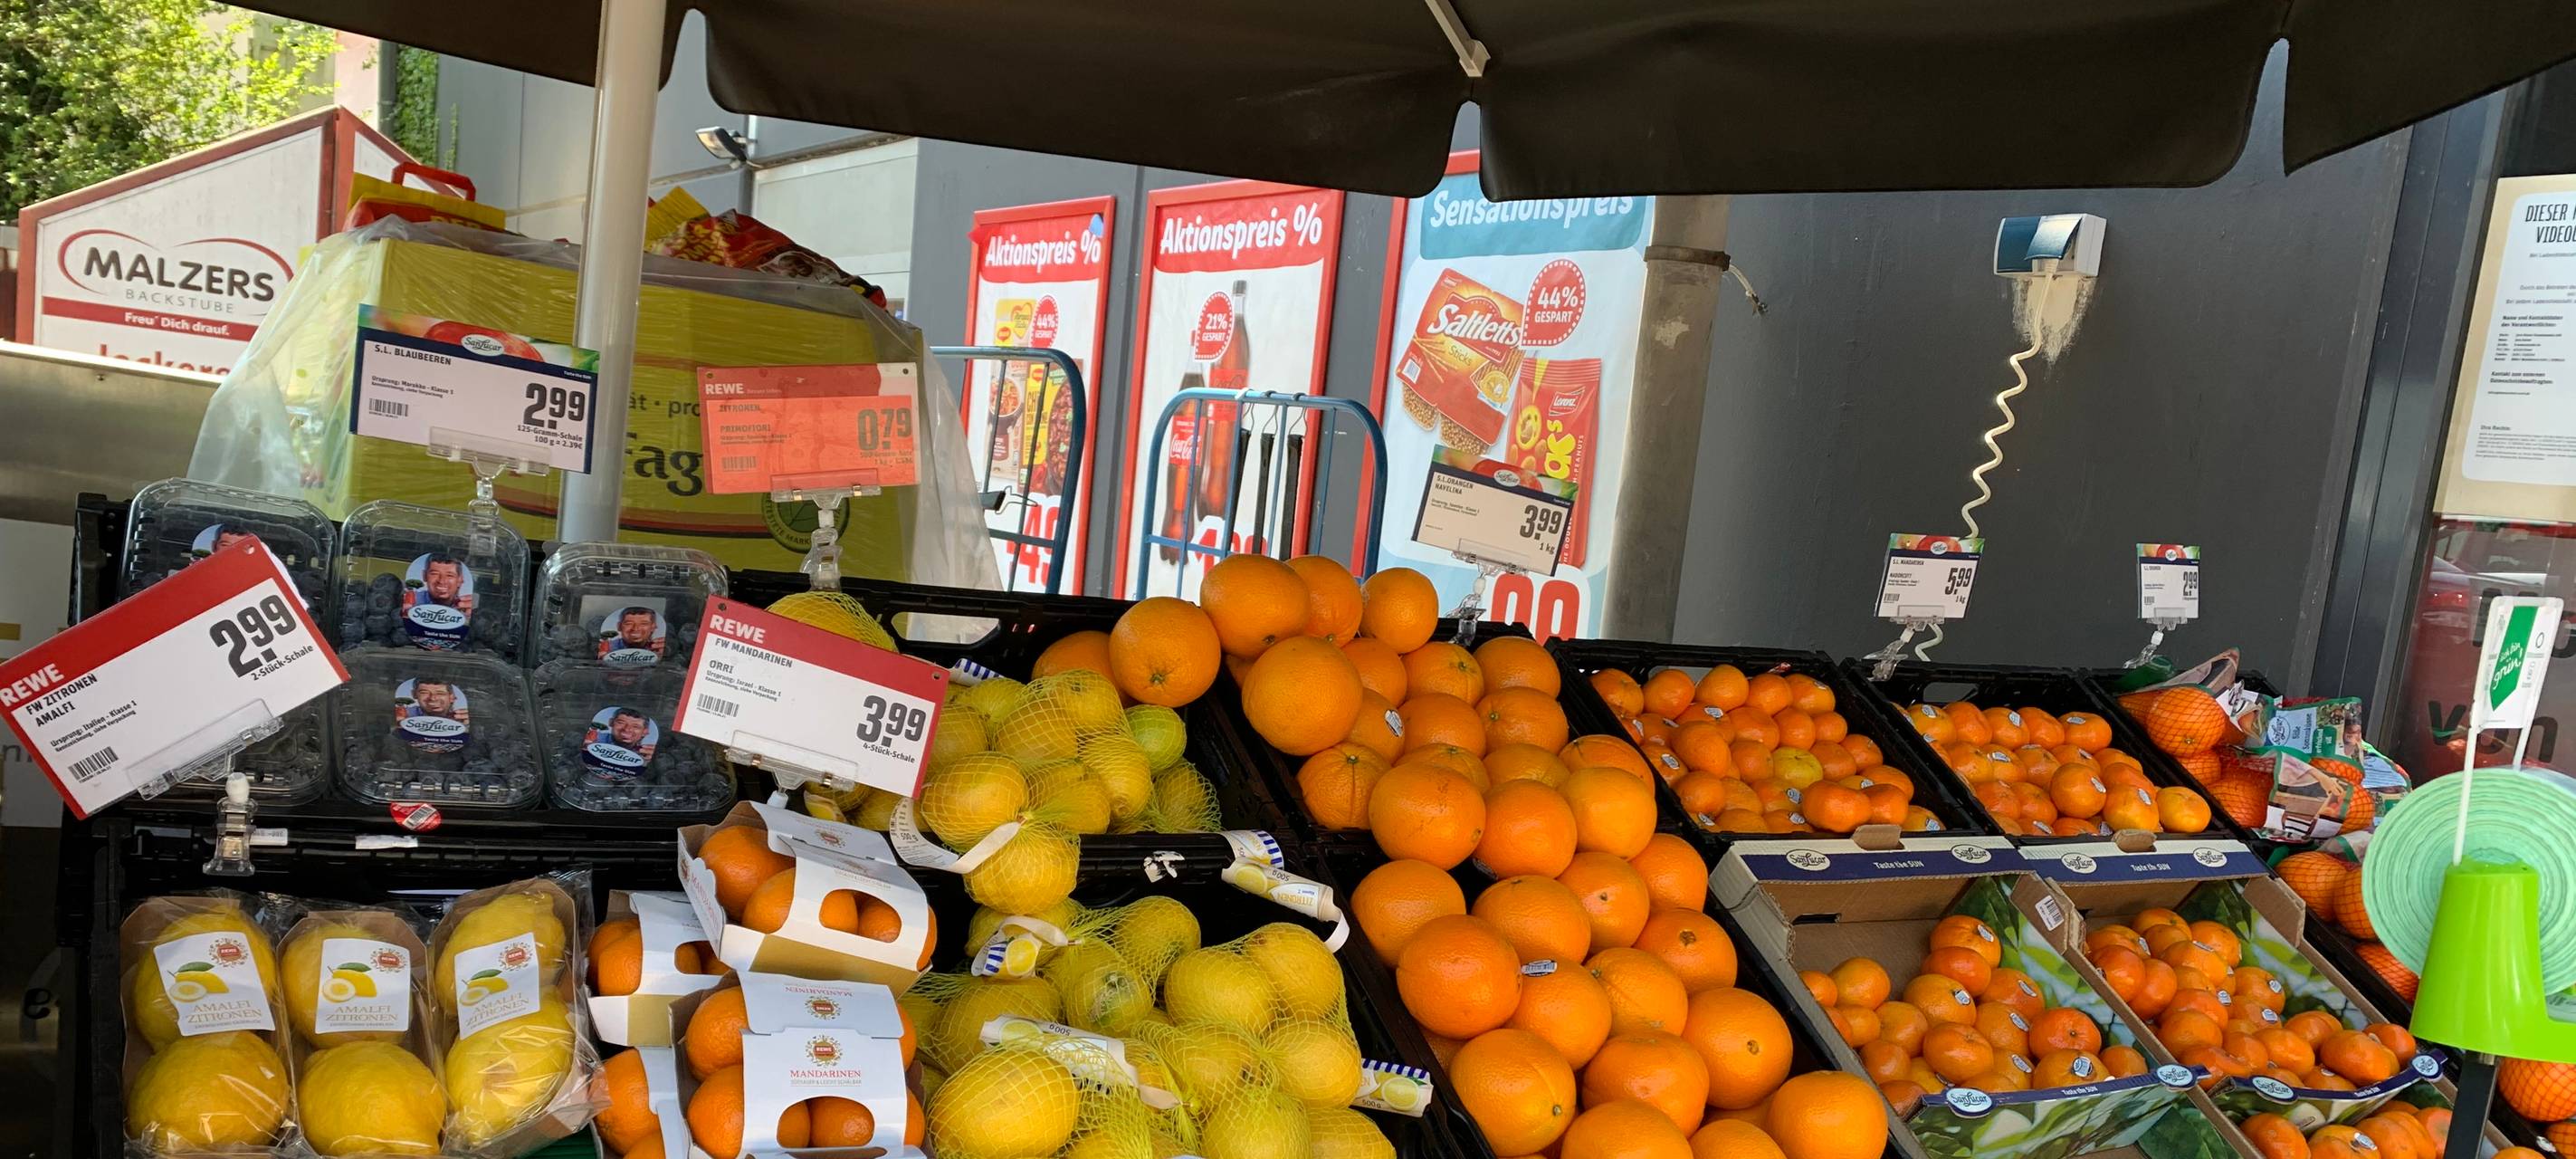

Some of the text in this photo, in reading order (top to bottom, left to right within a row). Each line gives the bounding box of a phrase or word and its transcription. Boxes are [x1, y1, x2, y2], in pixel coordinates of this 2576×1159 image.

[2524, 204, 2568, 222] DIESER
[1159, 202, 1322, 260] Aktionspreis %
[985, 231, 1076, 273] Aktionspreis
[84, 246, 273, 302] MALZERS
[126, 289, 234, 314] BACKSTUBE
[1537, 286, 1579, 309] 44%
[161, 317, 189, 330] Dich
[192, 321, 230, 336] drauf.
[1205, 313, 1227, 330] 21%
[1534, 311, 1573, 323] GESPART
[375, 344, 452, 366] S.L. BLAUBEEREN
[705, 383, 744, 394] REWE
[523, 382, 585, 429] 2.99
[857, 407, 911, 450] 0.79
[535, 436, 548, 444] 100
[1520, 504, 1562, 540] 3.99
[1545, 543, 1555, 555] kg
[1945, 568, 1972, 595] 5.99
[413, 608, 463, 624] SanLucar
[209, 595, 297, 678] 2.99
[710, 614, 767, 644] REWE
[251, 644, 314, 682] 2-Stück-Schale
[715, 637, 793, 668] FW MANDARINEN
[709, 659, 734, 674] ORRI
[0, 663, 65, 707] REWE
[25, 673, 98, 715] FW ZITRONEN
[35, 701, 76, 727] AMALFI
[82, 716, 106, 731] Italien
[109, 704, 131, 717] Klasse
[856, 694, 927, 748] 3.99
[405, 719, 462, 732] SanLucar
[591, 744, 641, 763] SanLucar
[863, 742, 915, 763] 4-Stück-Schale
[1874, 862, 1895, 870] Taste
[1907, 860, 1924, 868] SUN
[186, 1009, 262, 1023] ZITRONEN
[194, 1000, 252, 1012] AMALFI
[335, 1005, 391, 1013] AMALFI
[1951, 1093, 1989, 1106] SanLucar
